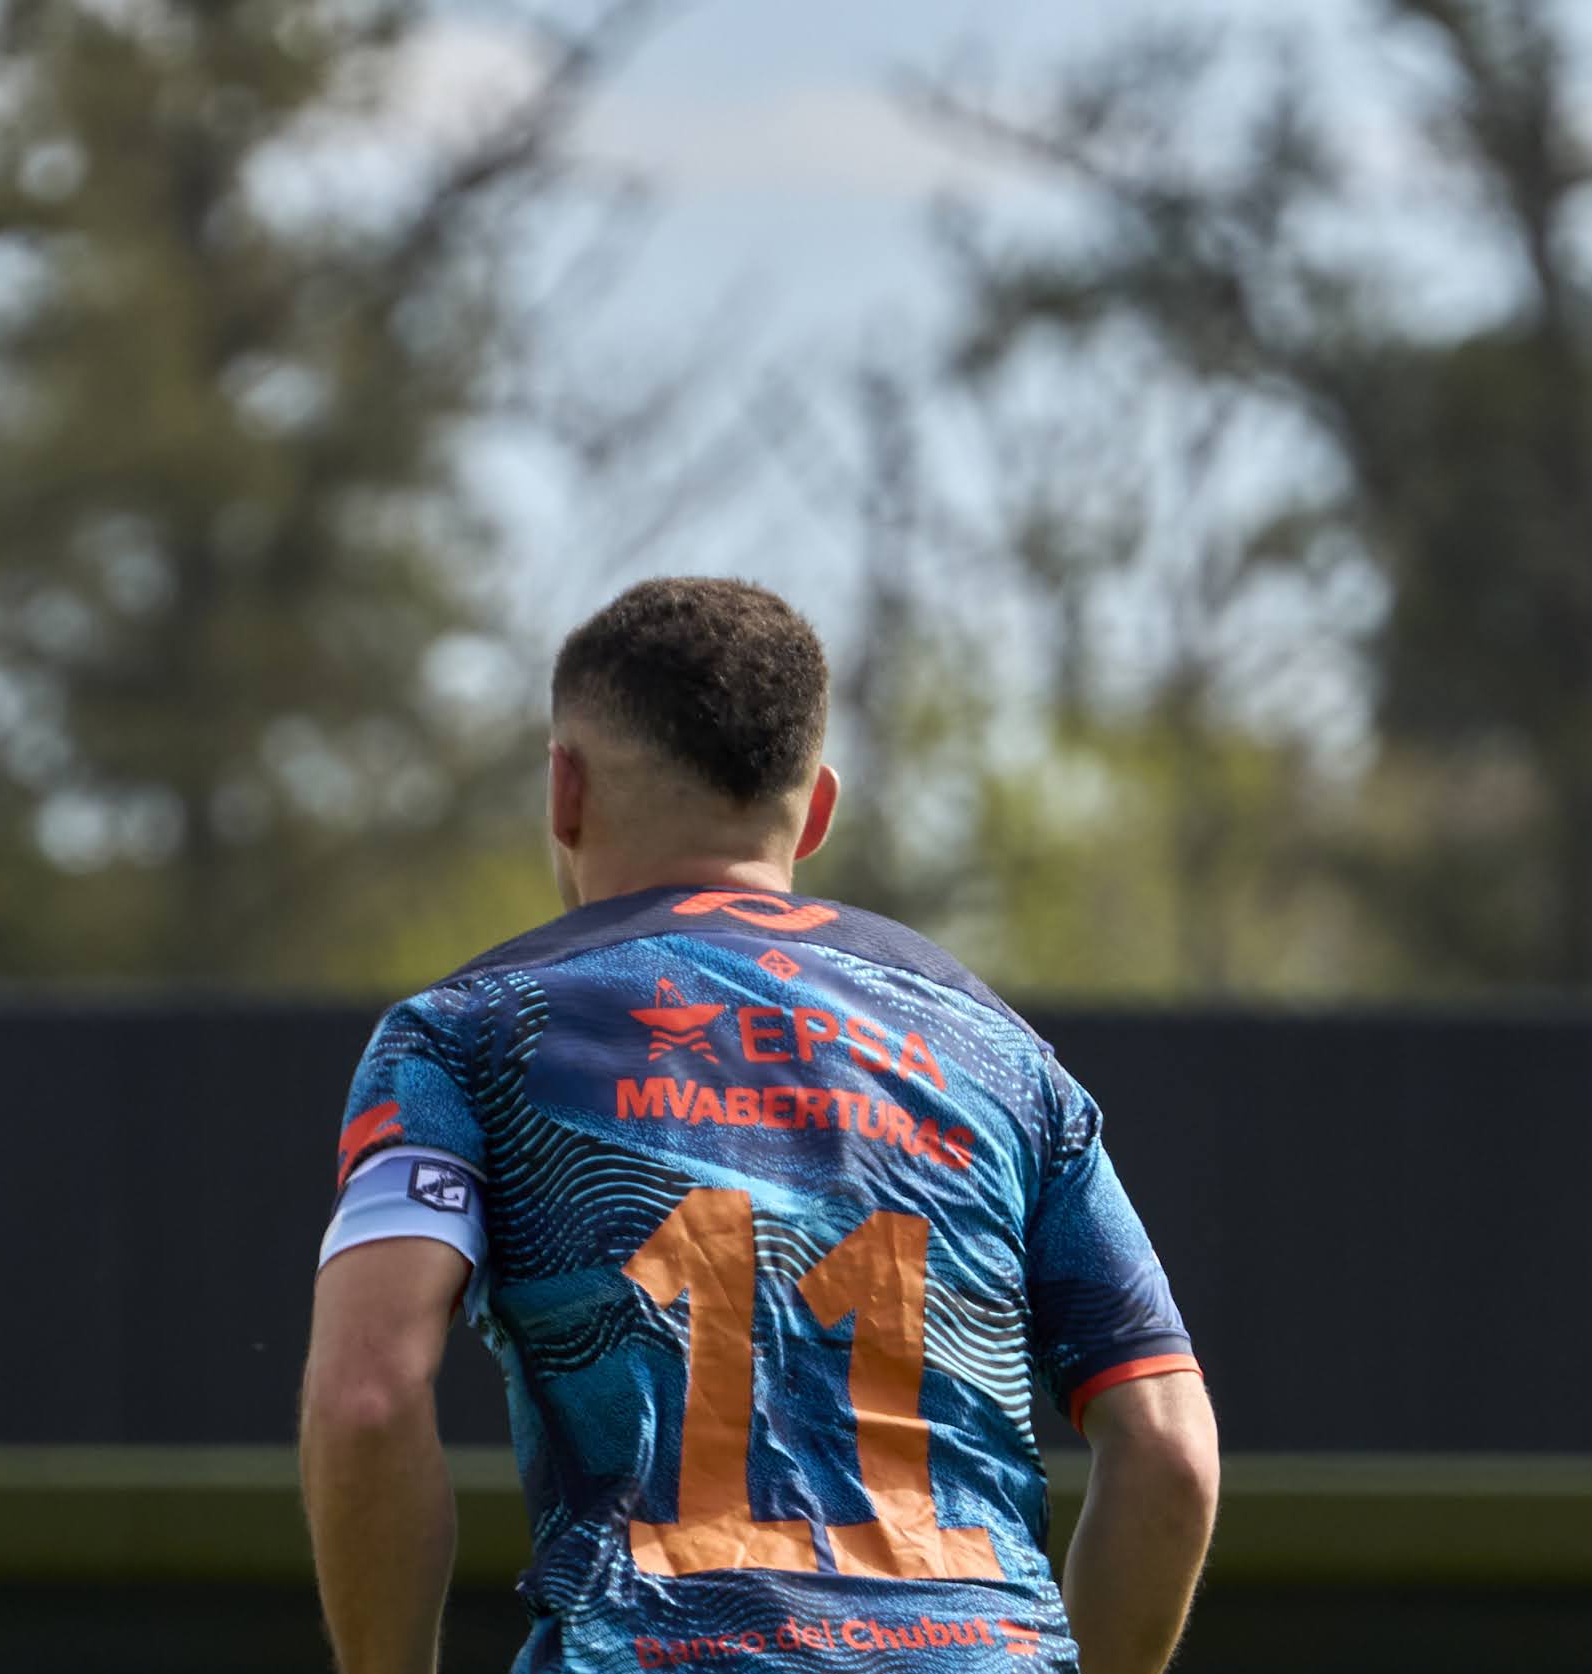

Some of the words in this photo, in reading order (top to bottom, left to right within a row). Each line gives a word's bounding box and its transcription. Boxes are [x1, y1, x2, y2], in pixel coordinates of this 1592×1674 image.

[737, 1006, 947, 1092] EPSA
[621, 1187, 1005, 1582] 11
[634, 1630, 767, 1669] Banco
[776, 1616, 834, 1650] del
[841, 1616, 996, 1652] Chubut
